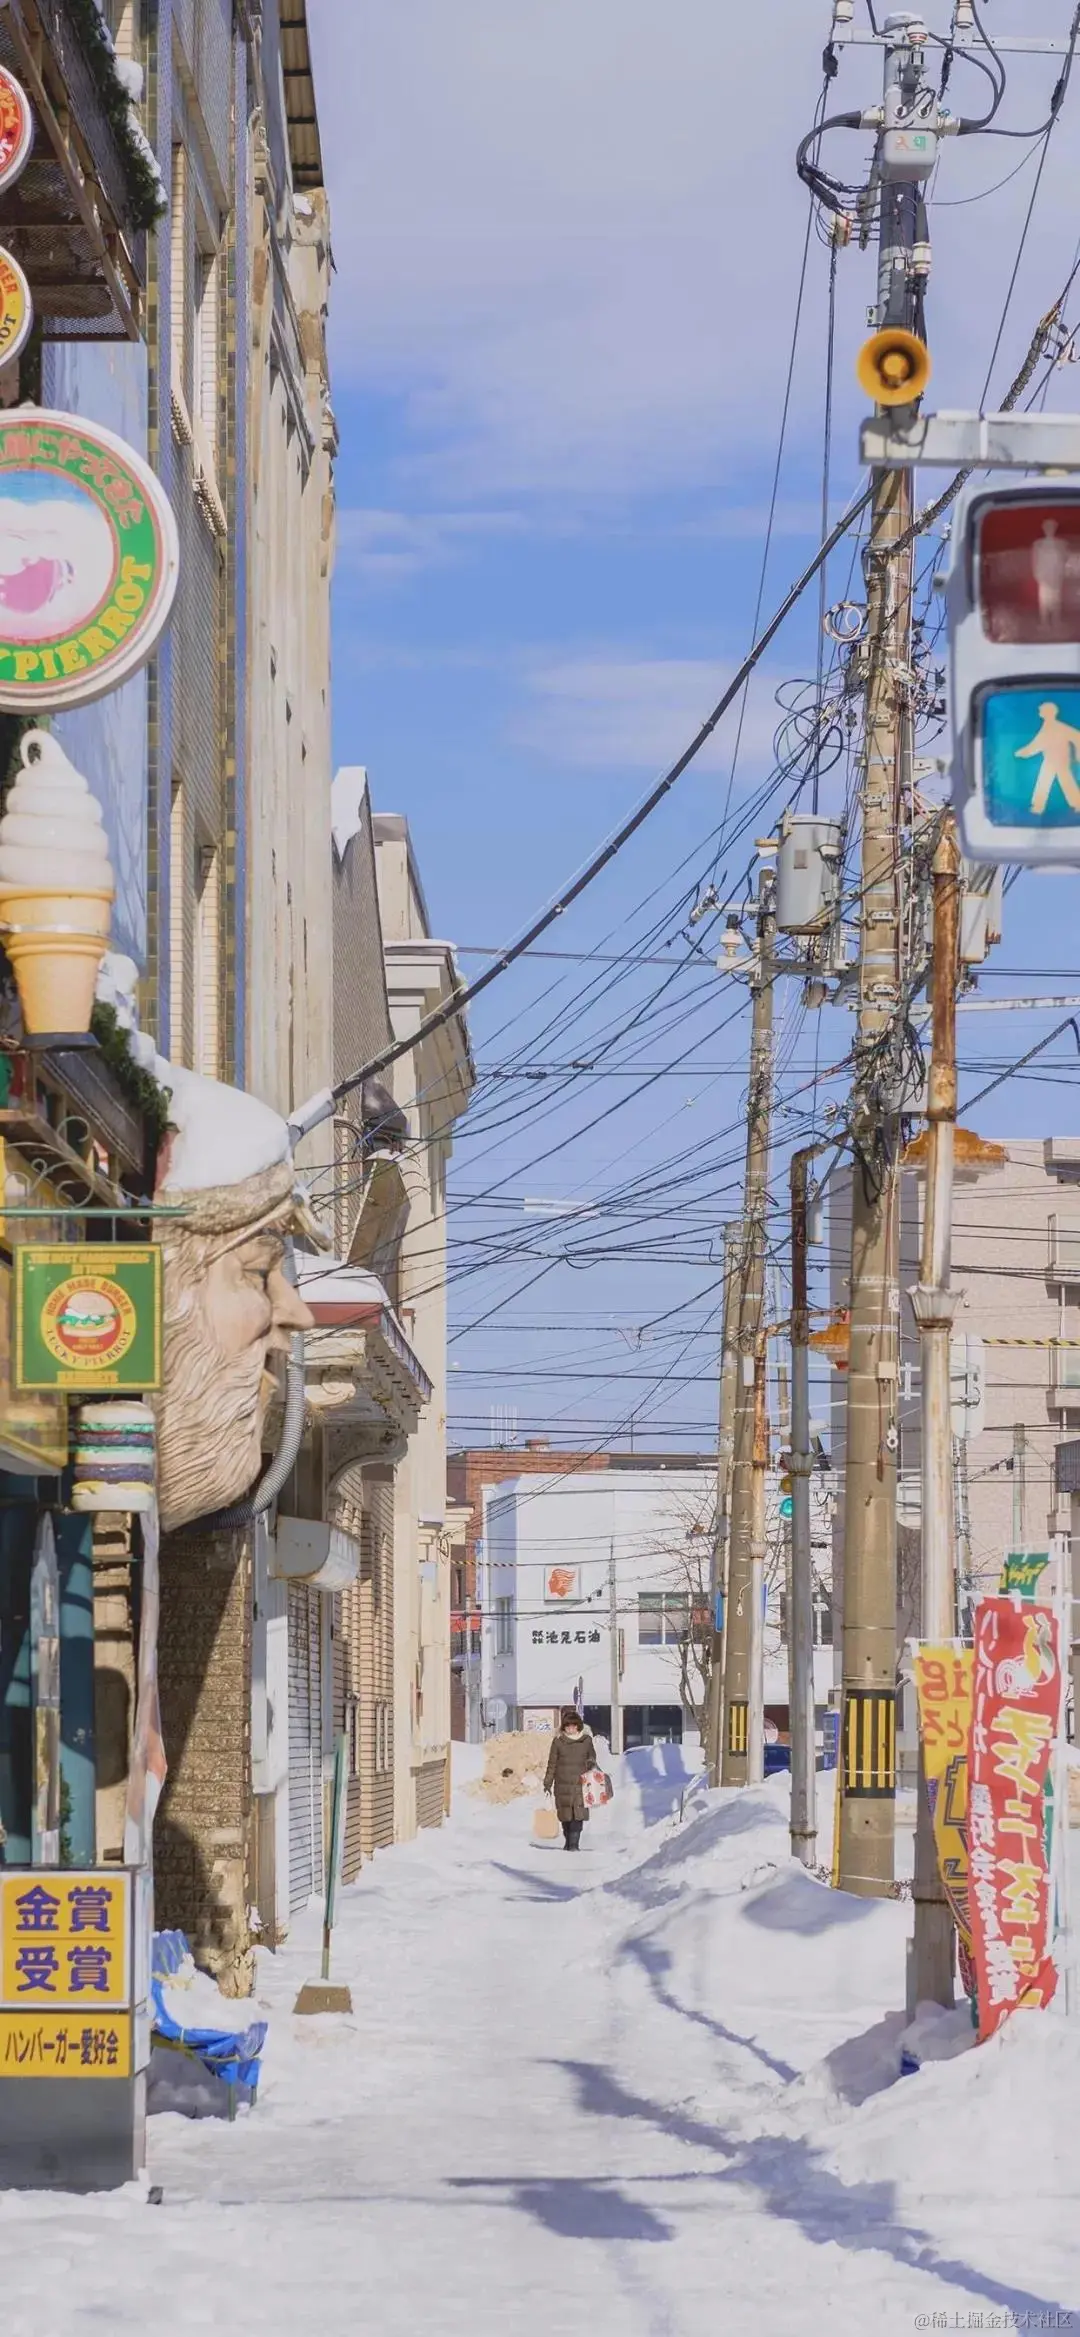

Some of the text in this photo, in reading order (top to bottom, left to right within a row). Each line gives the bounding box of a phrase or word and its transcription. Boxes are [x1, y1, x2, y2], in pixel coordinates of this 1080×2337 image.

[13, 555, 153, 681] PIERROT
[46, 1329, 131, 1367] LUCKY PIERROT
[15, 1885, 113, 1933] 金賞
[15, 1945, 112, 1992] 受賞
[5, 2027, 119, 2066] ハンバーガー愛好会
